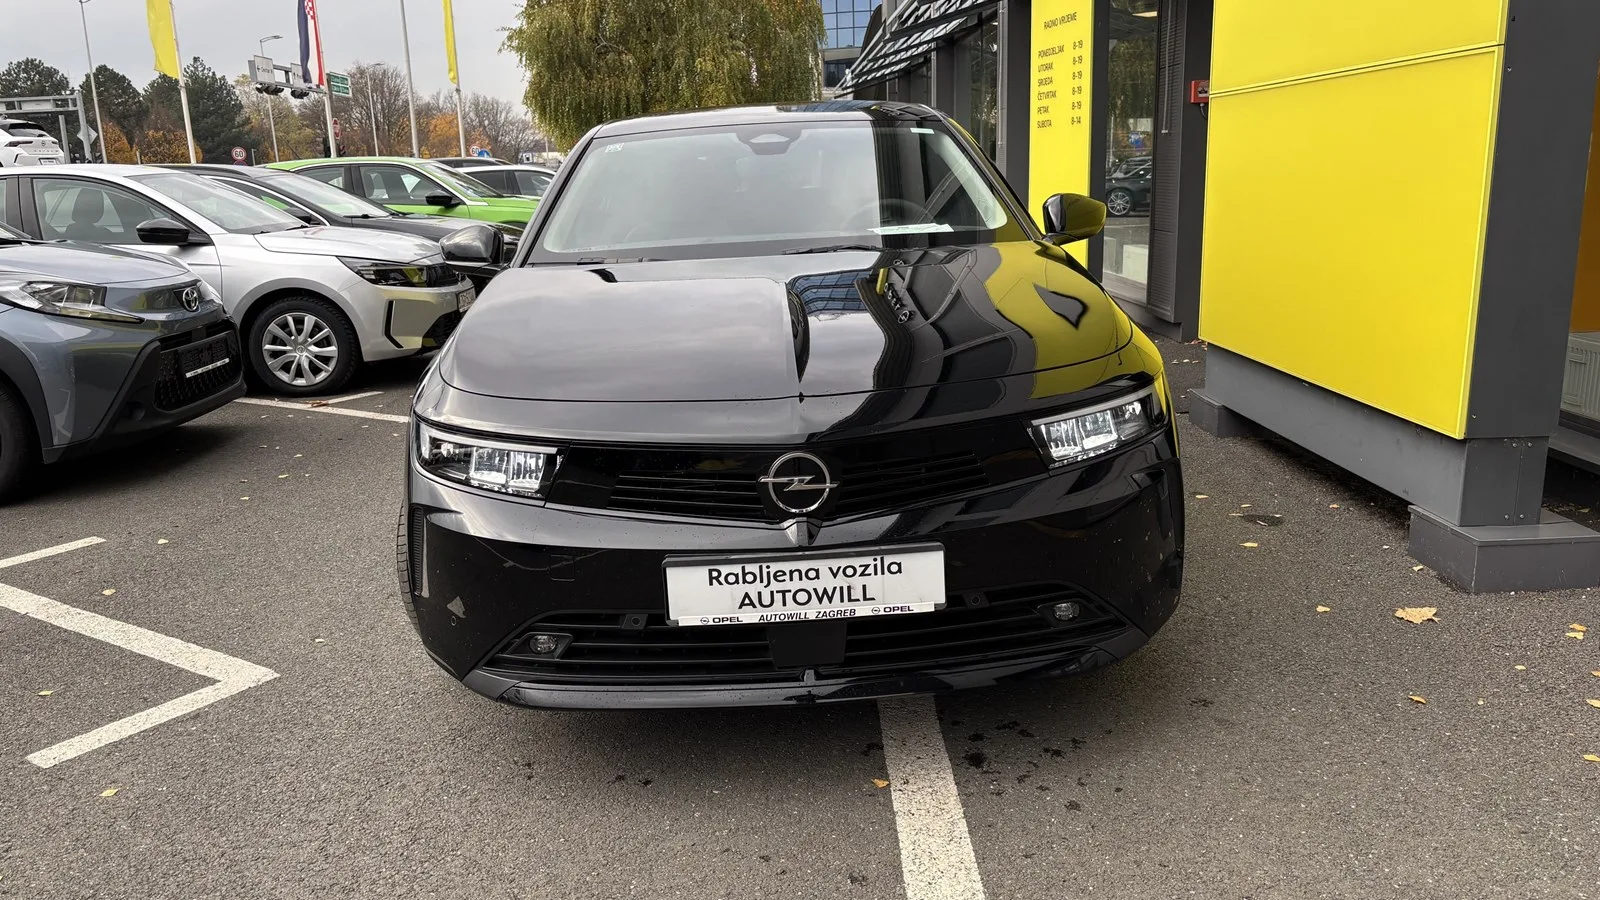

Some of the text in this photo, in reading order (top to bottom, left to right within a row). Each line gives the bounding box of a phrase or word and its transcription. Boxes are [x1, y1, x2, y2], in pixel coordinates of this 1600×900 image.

[1044, 17, 1058, 30] RADNO
[1038, 62, 1054, 73] UTORAK
[1037, 105, 1050, 115] PETAK
[1037, 119, 1052, 129] SUBOTA
[235, 150, 243, 158] 60
[707, 556, 903, 588] Rabljena vozila
[738, 584, 876, 610] AUTOWILL
[712, 605, 914, 624] OPEL AUTOWILL ZAGREB OPEL
